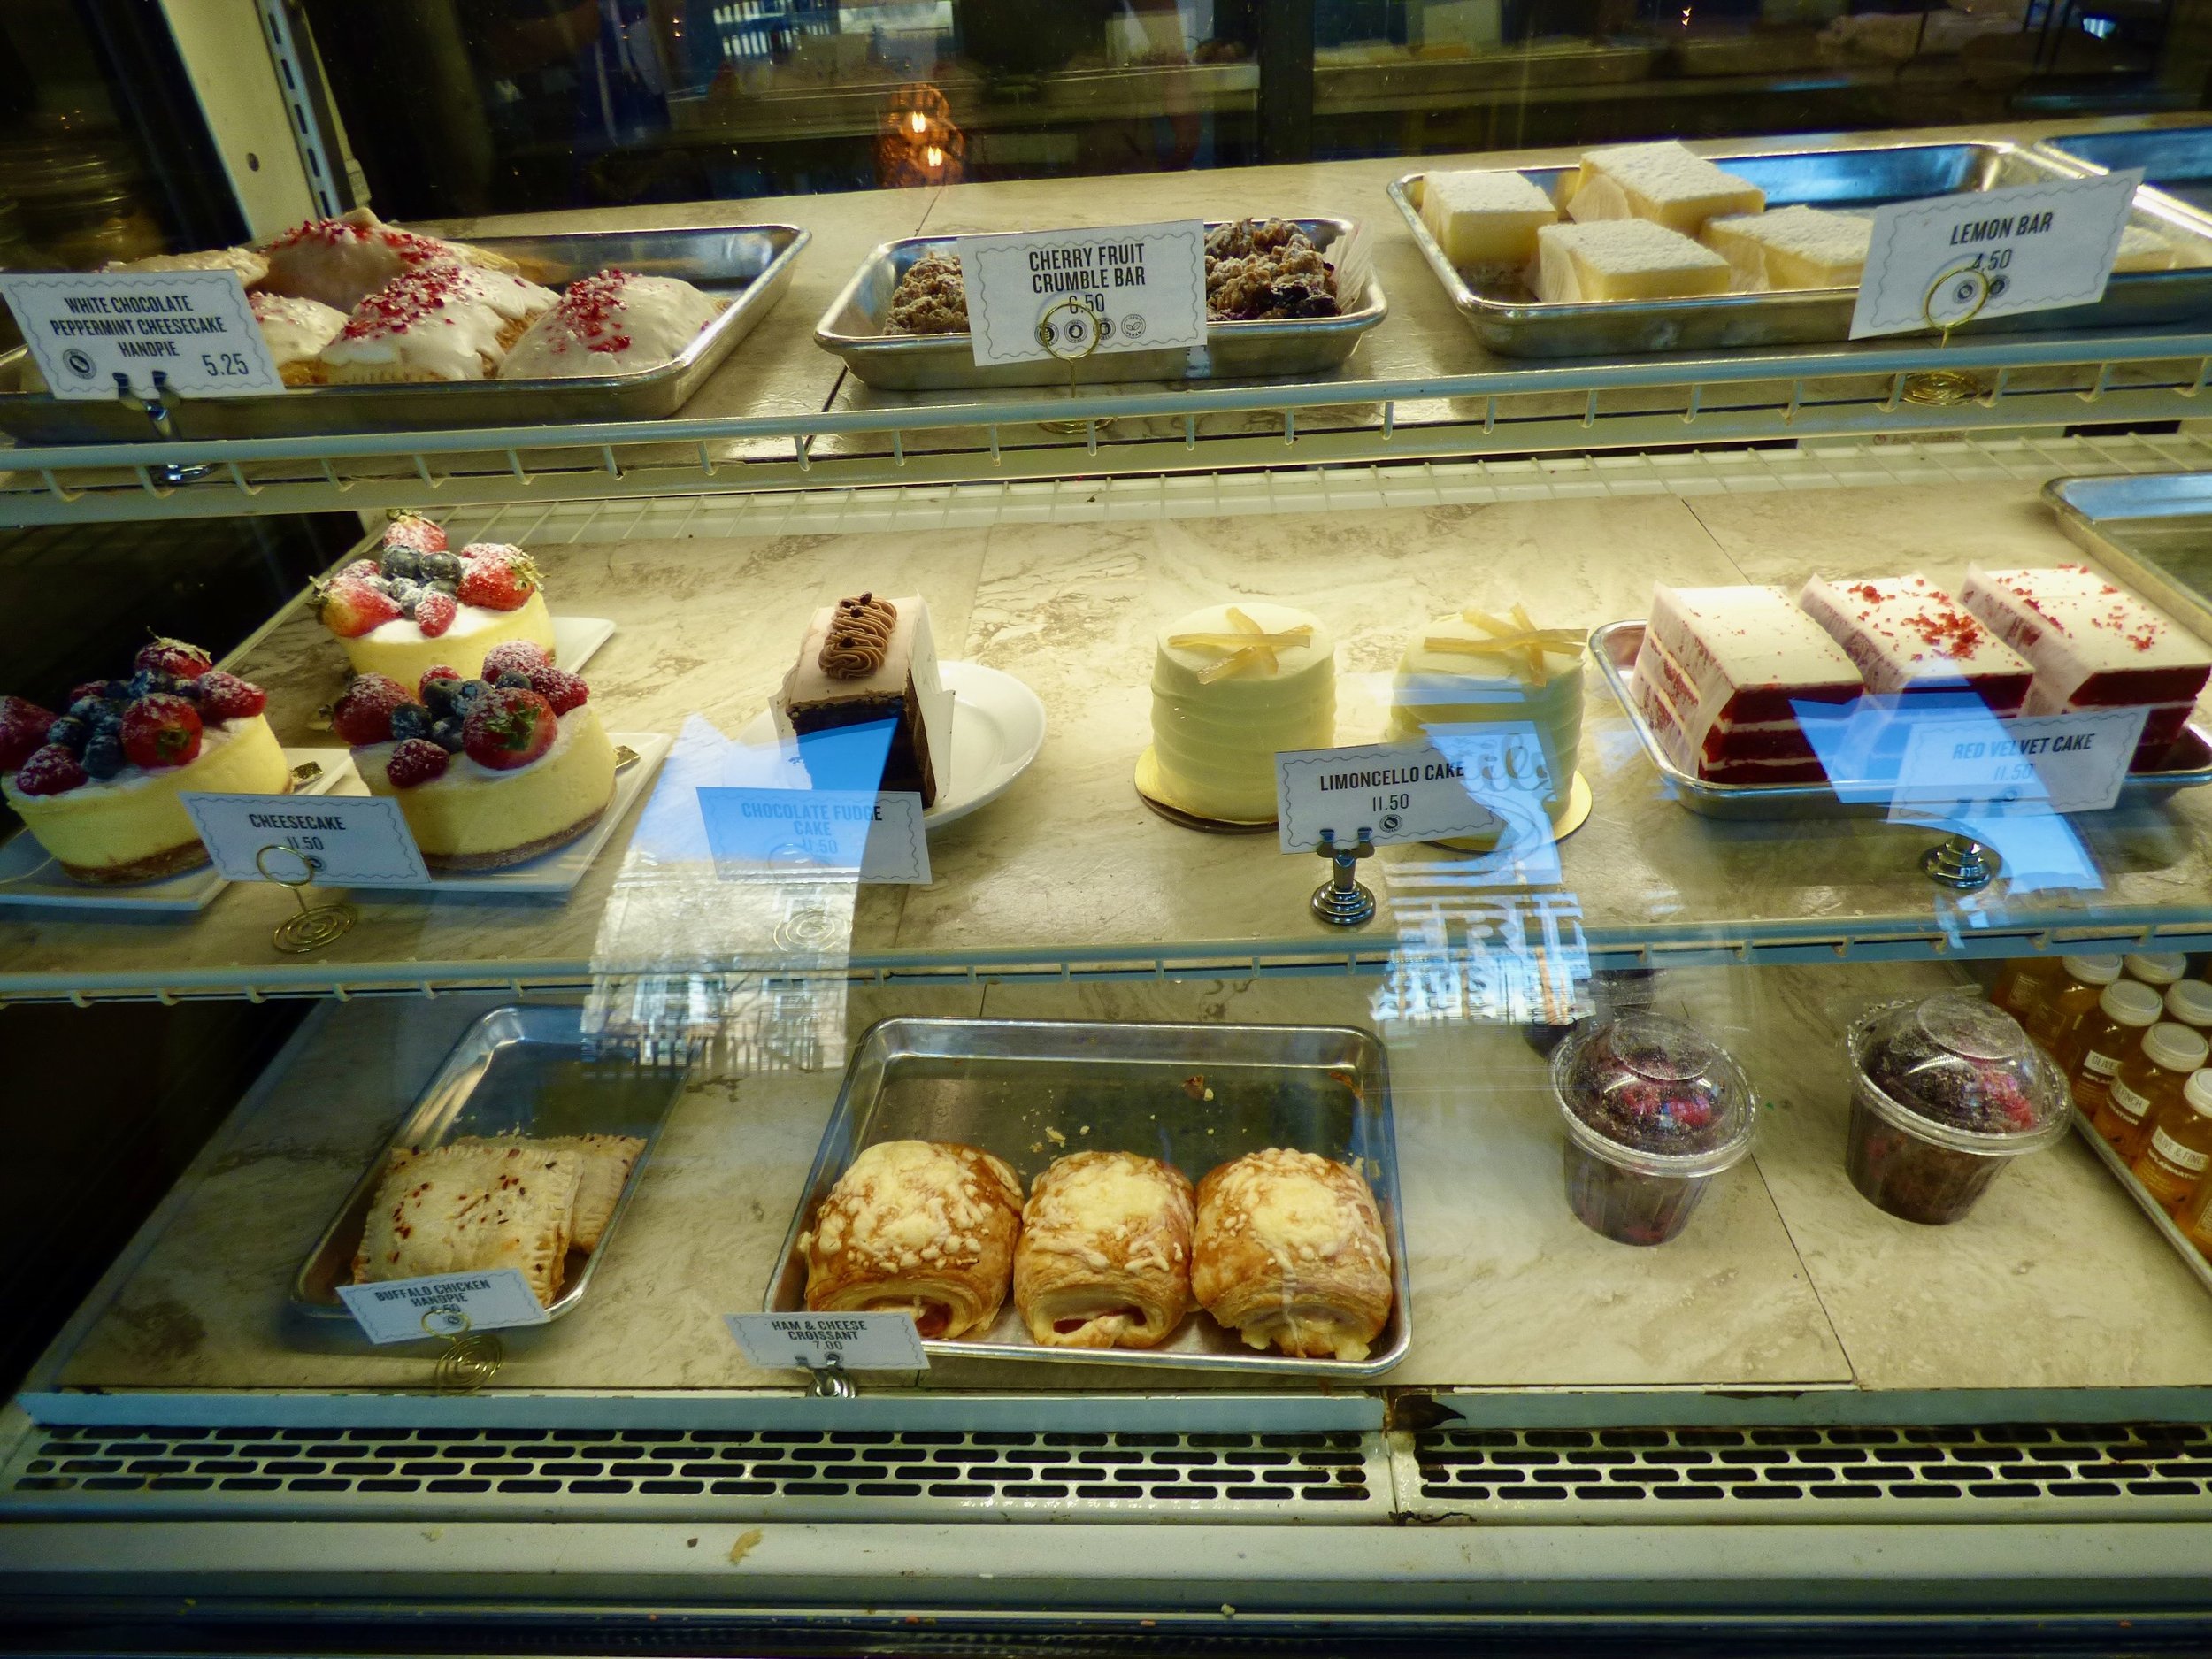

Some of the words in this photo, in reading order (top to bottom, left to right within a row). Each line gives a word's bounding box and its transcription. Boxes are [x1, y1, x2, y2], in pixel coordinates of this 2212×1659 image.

[1949, 217, 2014, 246] LEMON
[2016, 211, 2054, 235] BAR
[1029, 247, 1093, 272] CHERRY
[1098, 243, 1145, 265] FRUIT
[1969, 248, 2013, 272] 4.50
[1033, 268, 1110, 294] CRUMBLE
[1114, 265, 1146, 287] BAR
[65, 297, 111, 314] WHITE
[111, 296, 193, 313] CHOCOLATE
[1069, 293, 1105, 314] 6.50
[50, 319, 136, 336] PEPPERMINT
[137, 317, 227, 335] CHEESECAKE
[118, 341, 180, 357] HANDPIE
[202, 353, 249, 376] 5.25
[1952, 742, 1986, 760] RED
[1992, 737, 2051, 756] VELVET
[2052, 733, 2095, 752] CAKE
[1320, 766, 1419, 792] LIMONCELLO
[1425, 761, 1464, 780] CAKE
[1993, 763, 2033, 781] 11.50
[1372, 793, 1409, 812] 11.50
[741, 803, 829, 820] CHOCOLATE
[833, 805, 883, 821] FUDGE
[249, 813, 346, 830] CHEESECAKE
[794, 821, 831, 836] CAKE
[287, 836, 324, 851] 11.50
[802, 837, 838, 854] 11.50
[374, 1286, 433, 1302] BUFFALO
[434, 1279, 491, 1294] CHICKEN
[411, 1293, 468, 1308] HANDPIE
[772, 1320, 802, 1331] HAM
[805, 1320, 815, 1331] &
[818, 1320, 867, 1331] CHEESE
[787, 1331, 860, 1340] CROISSANT
[812, 1340, 843, 1351] 7.00
